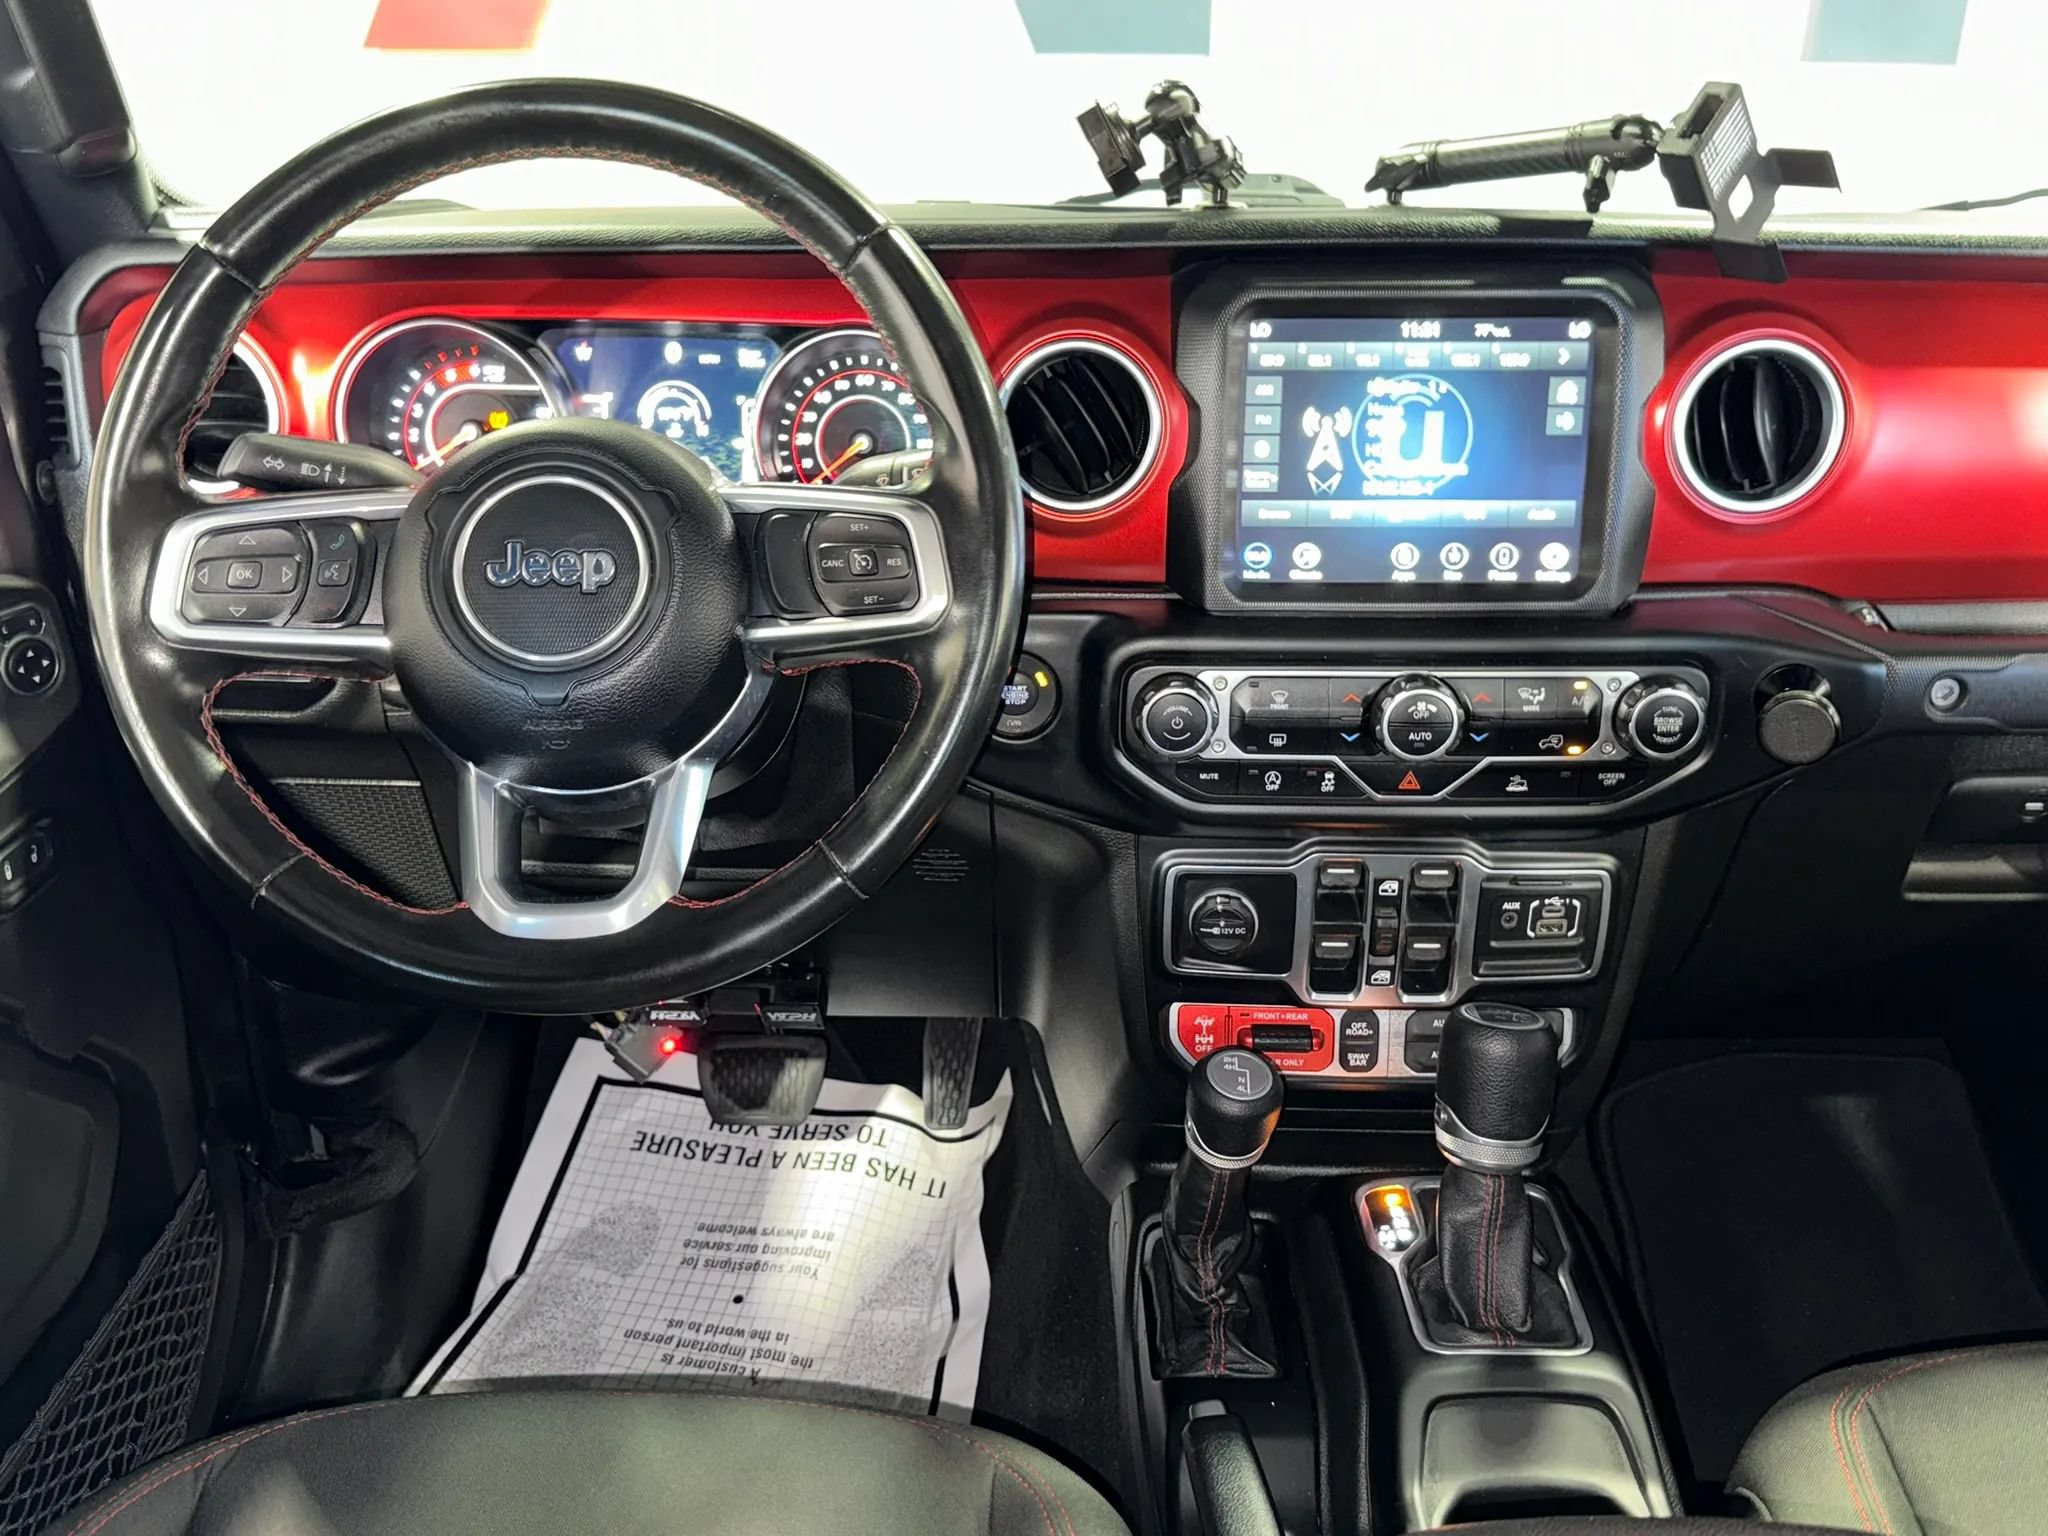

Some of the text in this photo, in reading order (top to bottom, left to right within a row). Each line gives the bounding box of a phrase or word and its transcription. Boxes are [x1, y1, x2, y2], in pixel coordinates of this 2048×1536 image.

[855, 374, 875, 386] 60
[484, 540, 616, 594] Jeep
[236, 569, 253, 580] OK
[28, 618, 37, 627] R
[1413, 710, 1430, 719] OFF
[1657, 725, 1680, 733] ENTER
[1408, 731, 1432, 741] AUTO
[1598, 772, 1625, 780] SCREEN
[1321, 785, 1335, 793] OFF
[1502, 901, 1521, 910] AUX
[1221, 927, 1246, 935] 12V DC
[1195, 1045, 1213, 1053] OFF
[1223, 1063, 1236, 1071] 4H
[1283, 1058, 1305, 1067] ONLY
[1236, 1085, 1248, 1093] 4L
[769, 1120, 851, 1141] SERVE
[857, 1125, 888, 1147] TO
[630, 1130, 946, 1199] IT HAS BEEN A PLEASURE
[760, 1226, 808, 1239] always
[812, 1230, 836, 1241] are
[683, 1238, 731, 1253] service
[733, 1241, 758, 1254] our
[680, 1256, 819, 1280] Your suggestions for
[663, 1316, 790, 1346] in the world to us.
[623, 1328, 814, 1370] the most important person
[660, 1352, 676, 1366] is
[678, 1357, 747, 1377] customer
